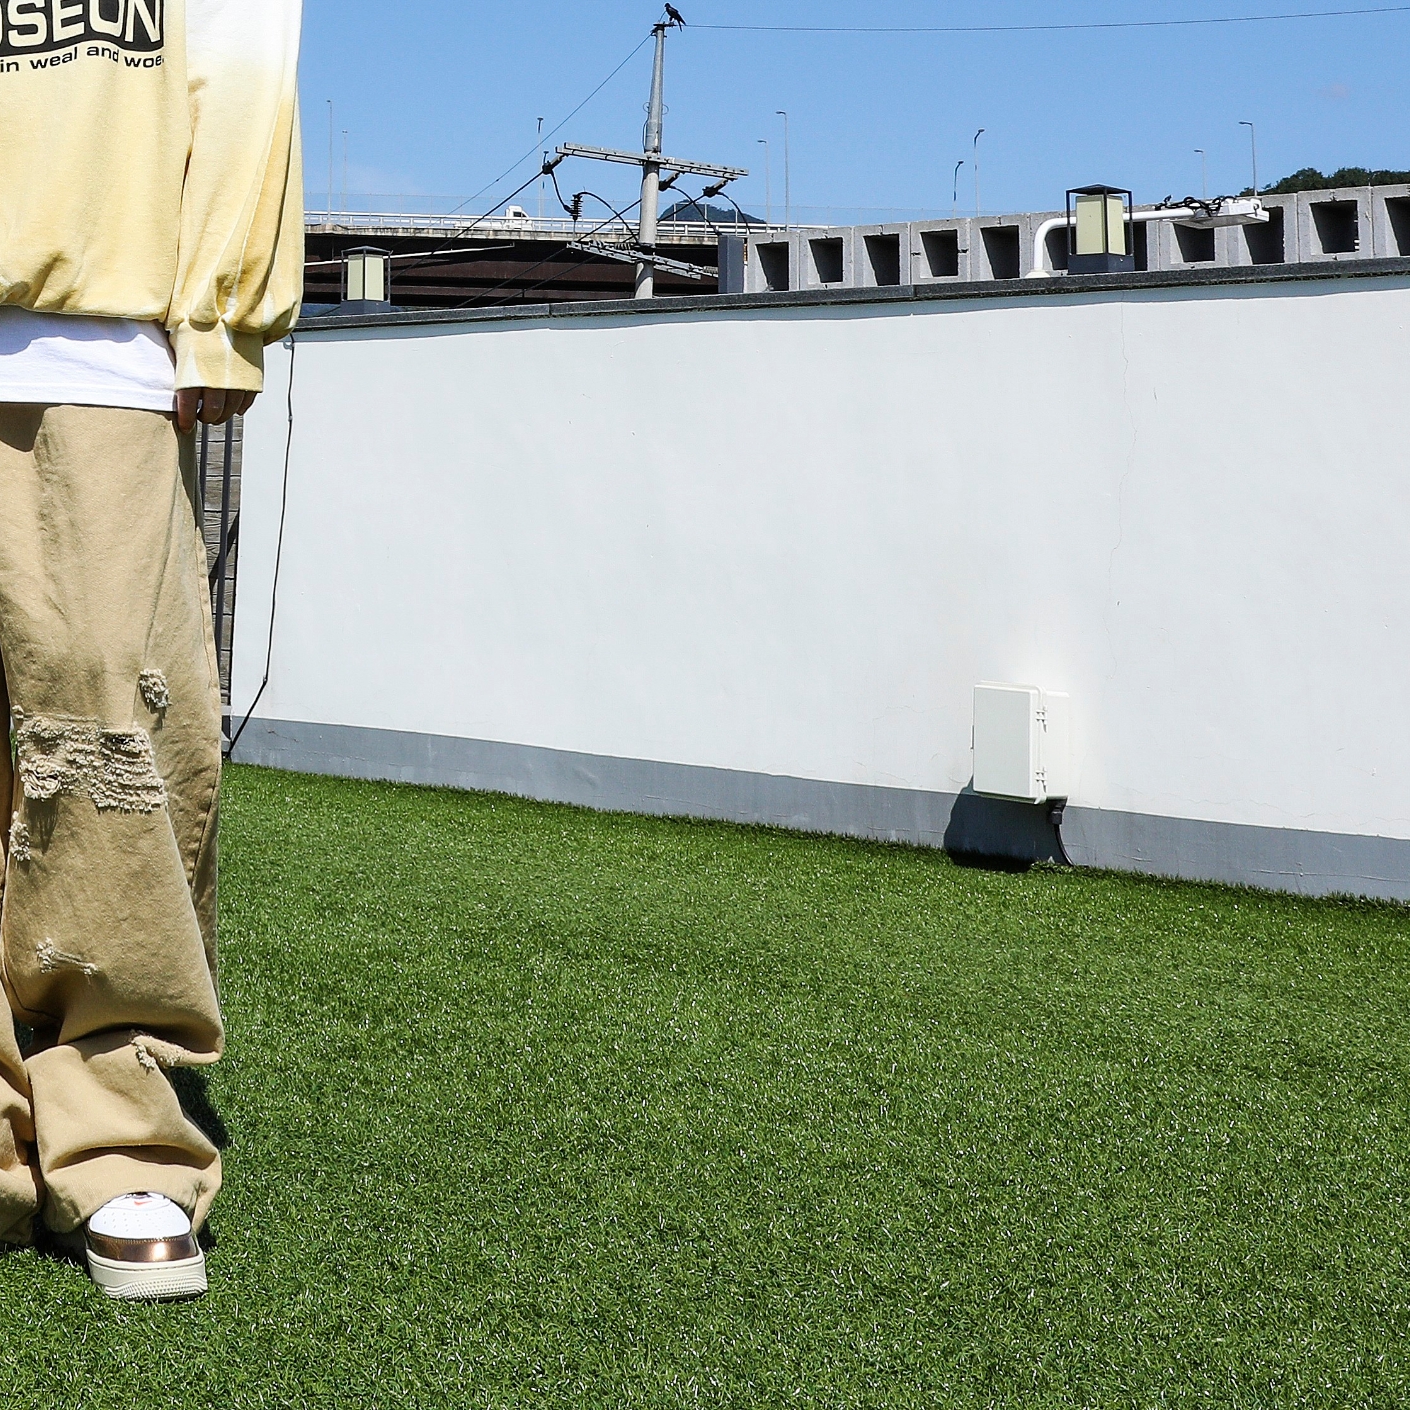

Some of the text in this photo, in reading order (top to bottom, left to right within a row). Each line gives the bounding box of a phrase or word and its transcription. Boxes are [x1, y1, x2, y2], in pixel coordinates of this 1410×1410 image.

[0, 59, 19, 73] in
[30, 47, 78, 70] weal
[86, 46, 119, 64] and
